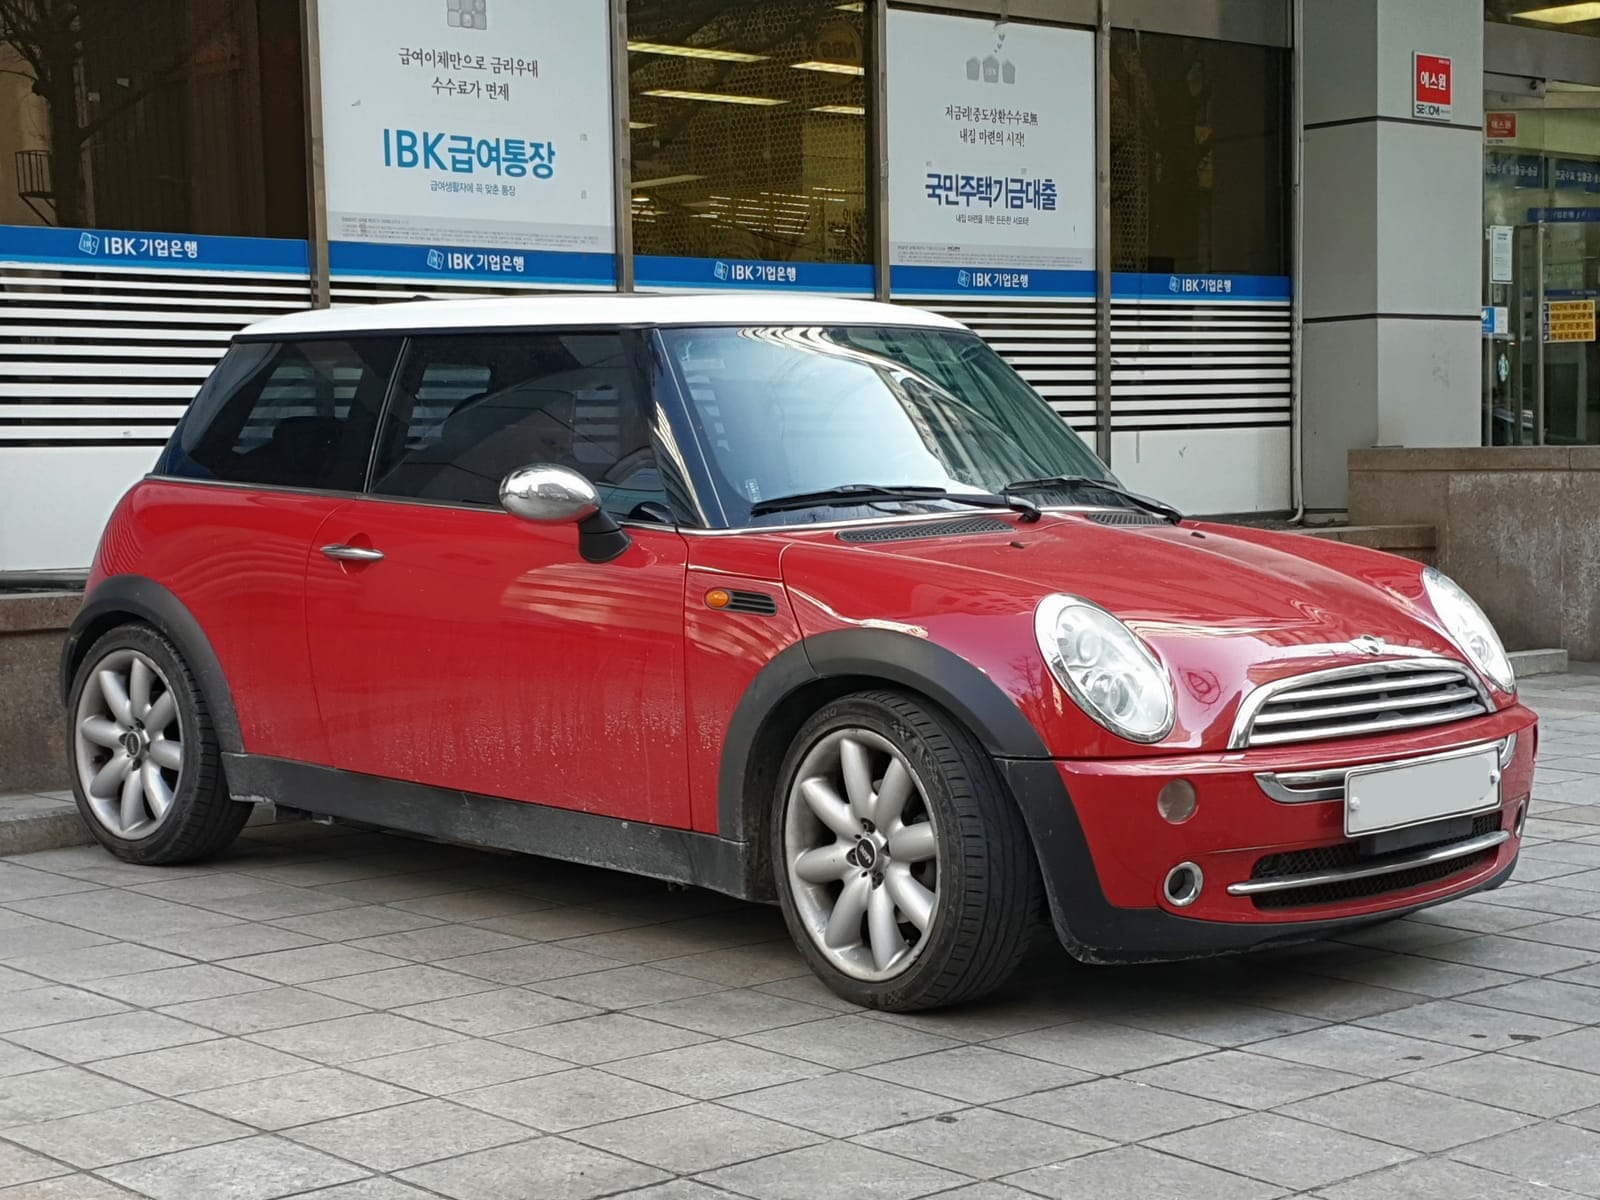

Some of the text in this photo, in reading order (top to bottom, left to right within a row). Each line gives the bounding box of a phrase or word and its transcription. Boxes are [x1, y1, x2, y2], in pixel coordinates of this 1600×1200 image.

[398, 47, 539, 78] 급여이체만으로 금리우대
[431, 77, 510, 101] 수수료가 면제
[1420, 71, 1446, 91] 에스원
[1416, 103, 1440, 116] SECOM
[959, 128, 976, 144] 내집
[979, 129, 1004, 146] 마련의
[383, 128, 556, 180] IBK급여통장
[430, 180, 474, 193] 급여생활자에
[925, 173, 1057, 211] 국민주택기금대출
[104, 236, 137, 256] IBK
[139, 239, 198, 259] 기업은행
[448, 252, 525, 273] IBK 기업은행
[731, 264, 797, 282] IBK 기업은행
[972, 272, 1029, 289] IBK 기업은행
[1182, 278, 1232, 293] IBK 기업은행
